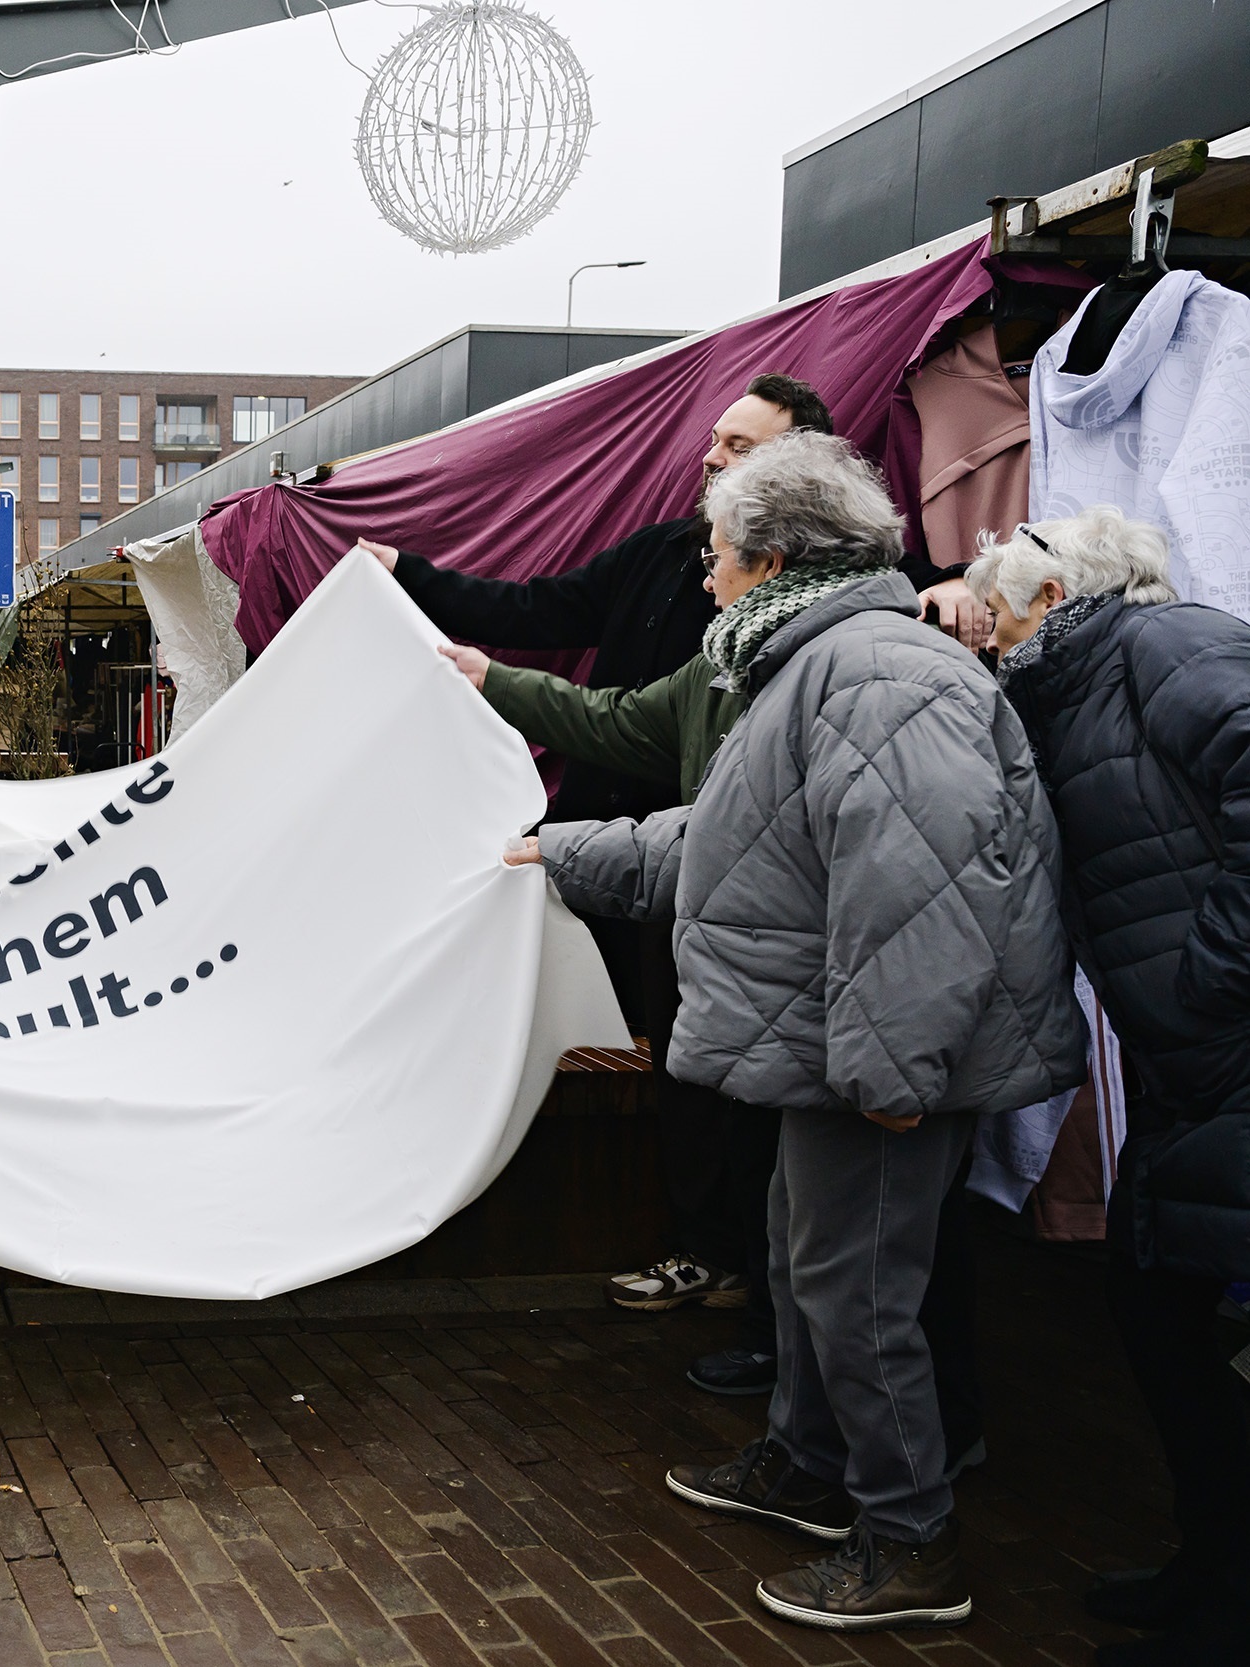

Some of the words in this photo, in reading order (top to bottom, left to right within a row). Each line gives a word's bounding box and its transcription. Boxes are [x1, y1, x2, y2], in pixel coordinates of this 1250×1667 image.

[1209, 444, 1240, 457] THE
[1190, 455, 1241, 475] SUPER
[1204, 466, 1241, 481] STAR
[1209, 582, 1247, 596] SUPER
